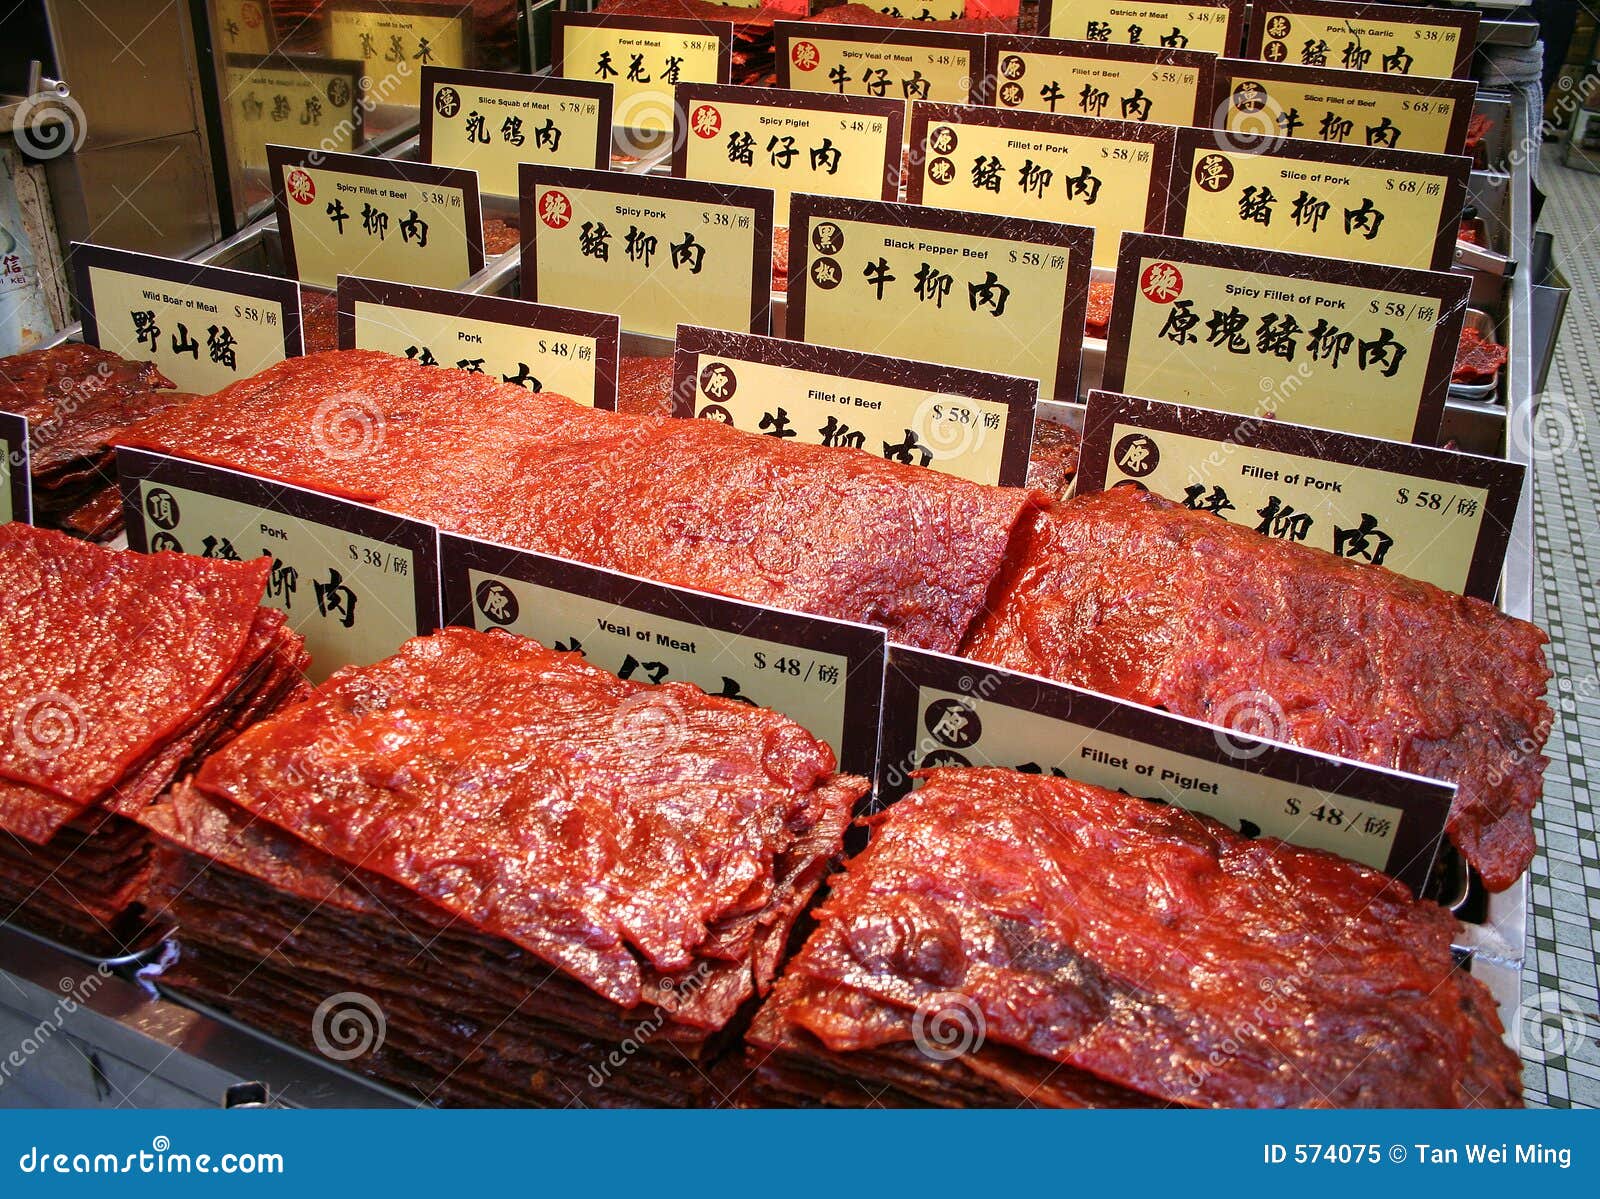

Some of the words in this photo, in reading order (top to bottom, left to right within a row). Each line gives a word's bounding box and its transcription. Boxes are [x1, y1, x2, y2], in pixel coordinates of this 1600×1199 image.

[1368, 29, 1393, 37] Garlic
[843, 51, 863, 59] Spicy
[498, 99, 520, 107] Squab
[532, 102, 549, 110] Meat
[760, 117, 782, 126] Spicy
[786, 119, 809, 127] Piglet
[1008, 141, 1030, 149] Fillet
[1046, 145, 1068, 153] Pork
[1281, 170, 1307, 180] Slice
[1325, 176, 1349, 185] Pork
[337, 183, 357, 193] Spicy
[360, 186, 377, 195] Fillet
[390, 191, 406, 199] Beef
[616, 206, 641, 217] Spicy
[644, 209, 666, 218] Pork
[885, 239, 914, 249] Black
[919, 243, 958, 255] Pepper
[963, 249, 988, 259] Beef
[143, 290, 160, 301] Wild
[163, 295, 183, 305] Boar
[186, 300, 193, 308] of
[197, 302, 217, 313] Meat
[1226, 285, 1260, 298] Spicy
[1264, 290, 1294, 302] Fillet
[1299, 296, 1311, 304] of
[1315, 297, 1345, 309] Pork
[458, 332, 482, 343] Pork
[809, 390, 835, 402] Fillet
[840, 396, 850, 404] of
[855, 398, 881, 410] Beef
[1242, 465, 1279, 481] Fillet
[1284, 475, 1299, 484] of
[1304, 477, 1342, 493] Pork
[261, 524, 288, 540] Pork
[598, 619, 630, 637] Veal
[636, 632, 650, 642] of
[657, 634, 696, 653] Meat
[1081, 747, 1128, 770] Fillet
[1135, 765, 1154, 776] of
[1161, 770, 1218, 795] Piglet
